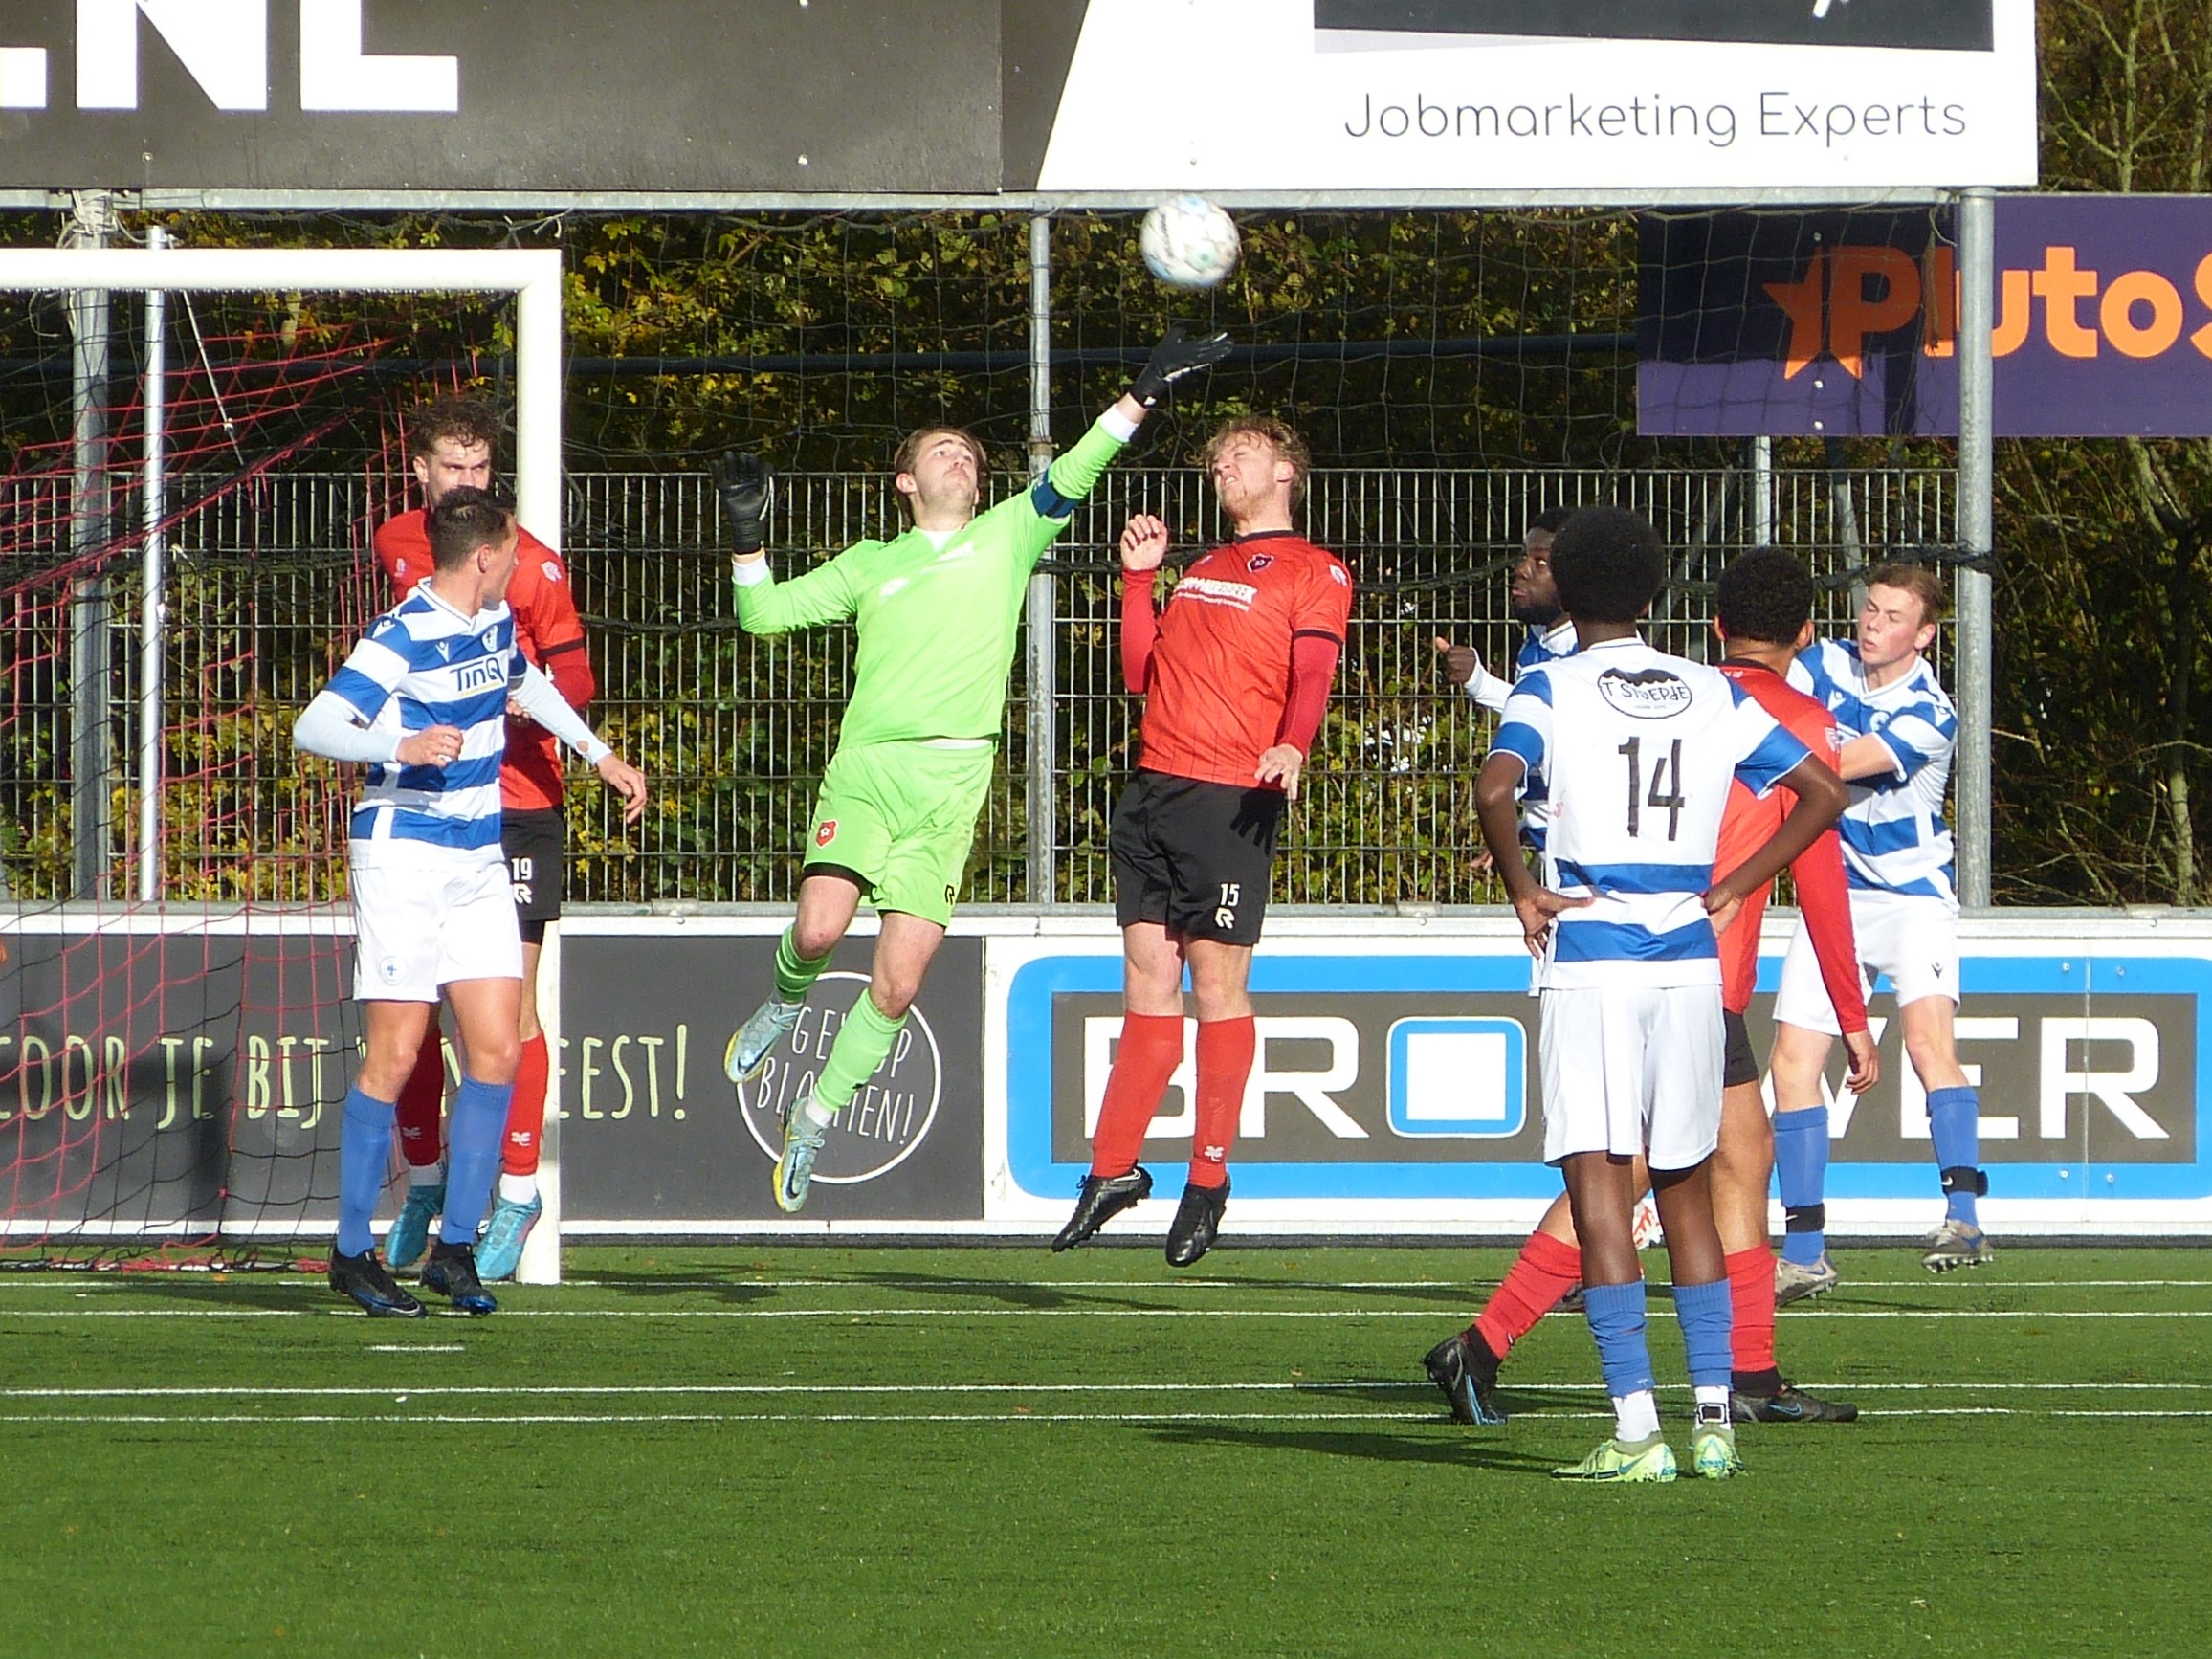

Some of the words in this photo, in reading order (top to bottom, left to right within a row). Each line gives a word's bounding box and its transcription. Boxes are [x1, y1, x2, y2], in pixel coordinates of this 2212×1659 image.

[1344, 92, 1736, 148] Jobmarketing
[1759, 91, 1967, 148] Experts
[1618, 736, 1686, 841] 14
[511, 857, 532, 881] 19
[1220, 883, 1240, 907] 15
[155, 1036, 214, 1129] JE
[248, 1034, 329, 1129] BIJ
